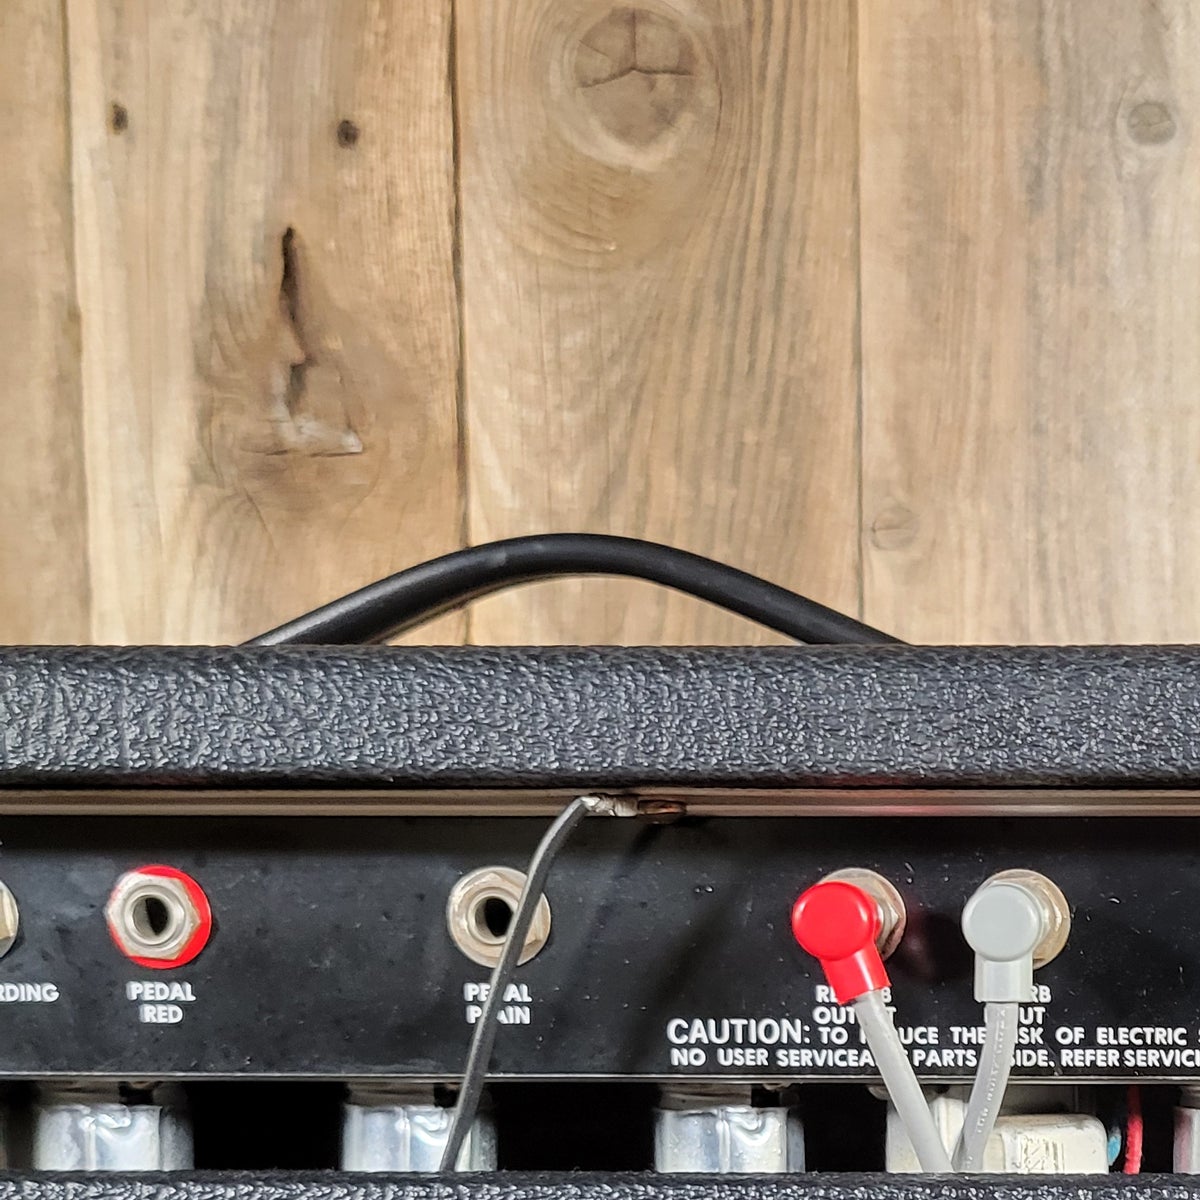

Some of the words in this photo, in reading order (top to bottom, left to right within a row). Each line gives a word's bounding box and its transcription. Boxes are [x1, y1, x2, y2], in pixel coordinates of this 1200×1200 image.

[126, 981, 197, 1002] PEDAL
[462, 981, 534, 1004] PEAL
[139, 1003, 183, 1024] RED
[465, 1004, 532, 1026] PAIN
[812, 1006, 897, 1026] OUTT
[666, 1018, 811, 1045] CAUTION:
[817, 1026, 849, 1045] TO
[948, 1025, 989, 1046] THE
[1055, 1026, 1085, 1045] OF
[1096, 1026, 1187, 1046] ELECTRIC
[670, 1047, 706, 1067] NO
[717, 1047, 769, 1067] USER
[774, 1046, 909, 1068] SERVICEA
[912, 1048, 978, 1067] PARTS
[1060, 1048, 1120, 1067] REFER
